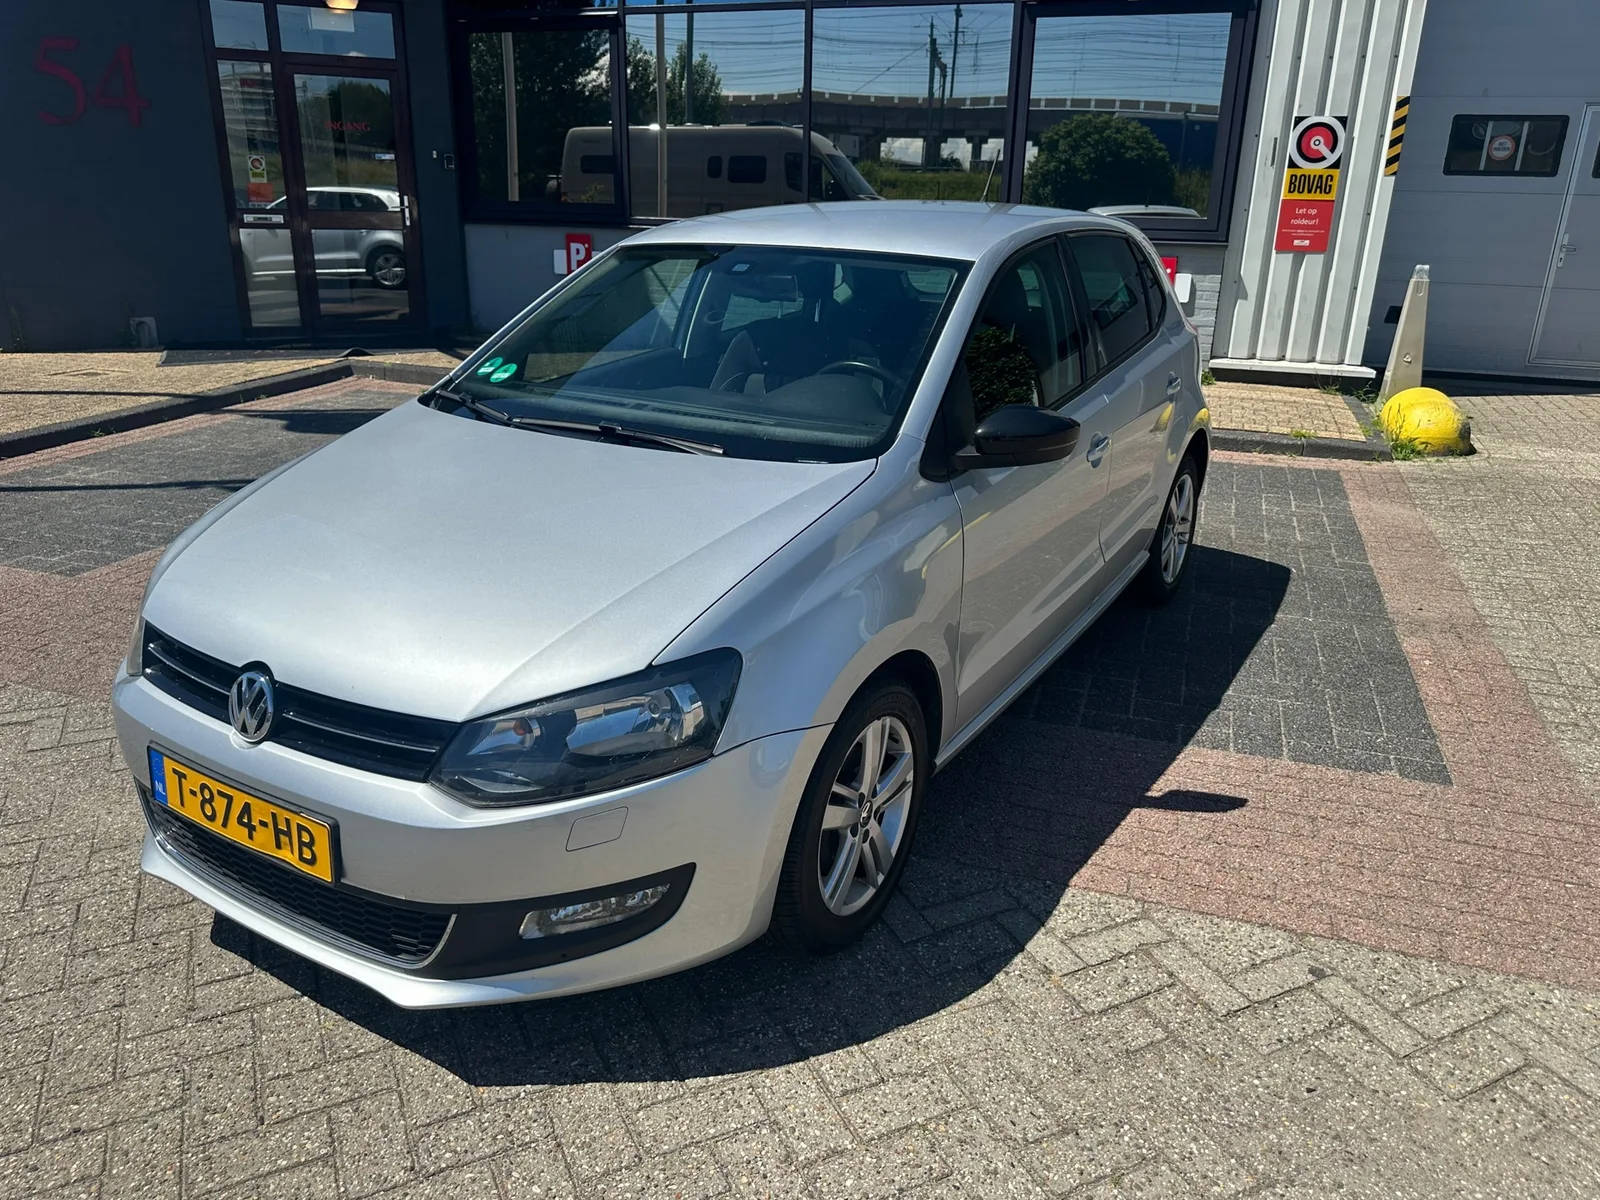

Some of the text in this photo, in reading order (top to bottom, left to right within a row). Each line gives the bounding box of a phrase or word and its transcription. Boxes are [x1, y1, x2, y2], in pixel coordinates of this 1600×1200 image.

[33, 36, 151, 127] 54
[1288, 174, 1334, 195] BOVAG
[154, 780, 166, 796] NL
[172, 767, 317, 866] T-874-HB
